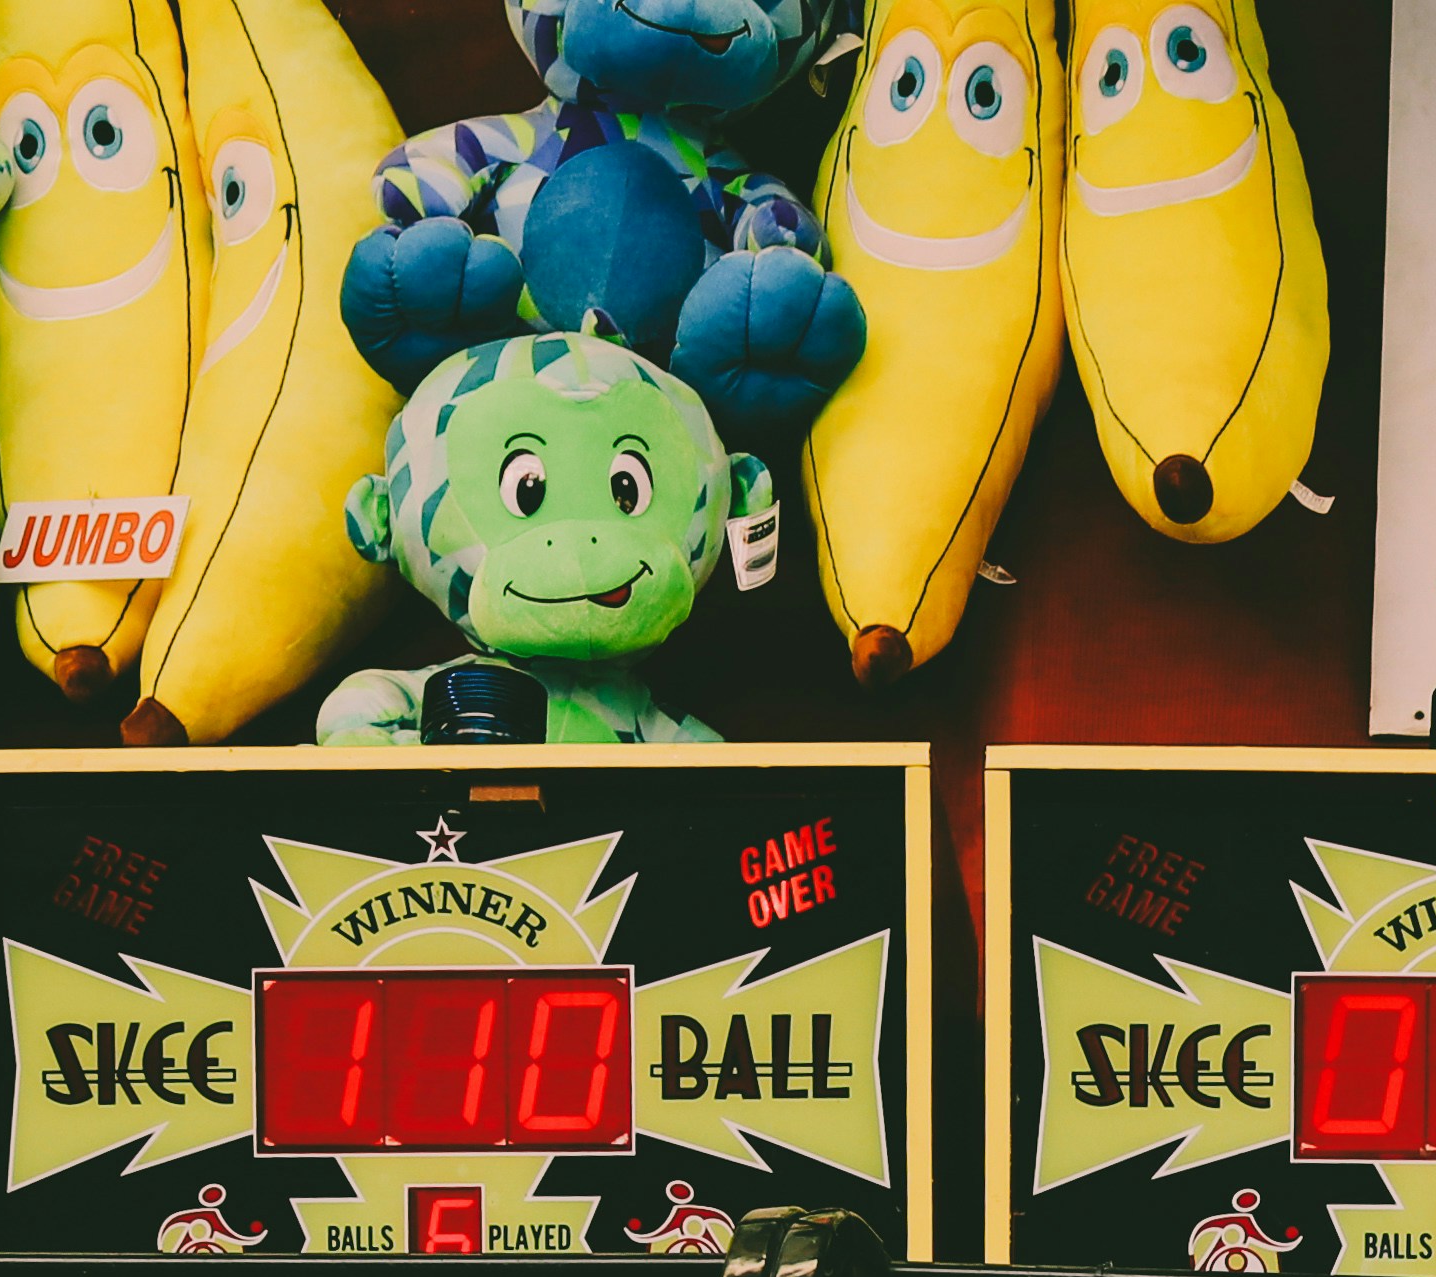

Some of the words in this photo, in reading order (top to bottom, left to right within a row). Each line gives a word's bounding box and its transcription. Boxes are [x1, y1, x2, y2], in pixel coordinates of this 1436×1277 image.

[3, 509, 174, 569] JUMBO
[740, 817, 837, 884] GAME
[1106, 834, 1207, 896] FREE
[331, 881, 550, 949] WINNER
[747, 864, 836, 928] OVER
[1087, 871, 1188, 936] GAME
[42, 1021, 237, 1107] SKEE
[340, 991, 618, 1131] 110
[650, 1013, 853, 1101] BALL
[1071, 1023, 1274, 1110] SKEE
[326, 1224, 395, 1252] BALLS
[489, 1224, 572, 1251] PLAYED
[1363, 1233, 1434, 1261] BALLS
